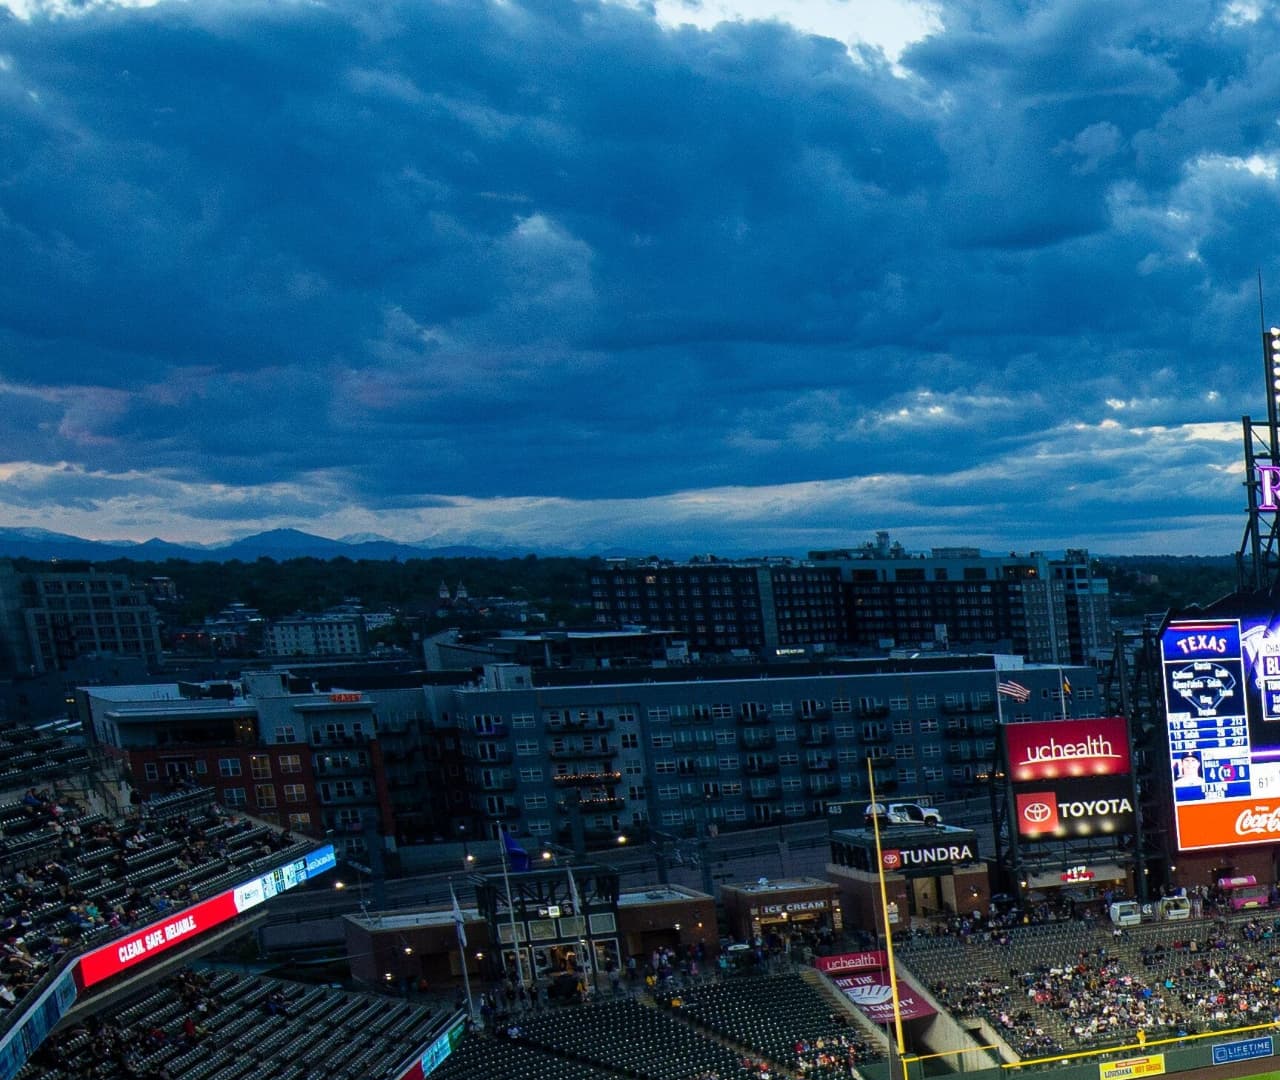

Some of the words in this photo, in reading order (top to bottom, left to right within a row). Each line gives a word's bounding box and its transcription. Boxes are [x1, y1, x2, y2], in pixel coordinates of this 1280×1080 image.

[1177, 635, 1227, 654] TEXAS
[1027, 734, 1113, 760] uchealth
[1058, 798, 1133, 818] TOYOTA
[900, 845, 973, 865] TUNDRA
[764, 905, 782, 913] ICE
[787, 901, 824, 911] CREAM
[118, 941, 145, 963] CLEAN.
[145, 929, 165, 950] SAFE.
[165, 915, 197, 940] RELIABLE.
[827, 953, 876, 969] uchealth
[855, 975, 875, 985] THE
[1228, 1042, 1270, 1055] LIFETIME
